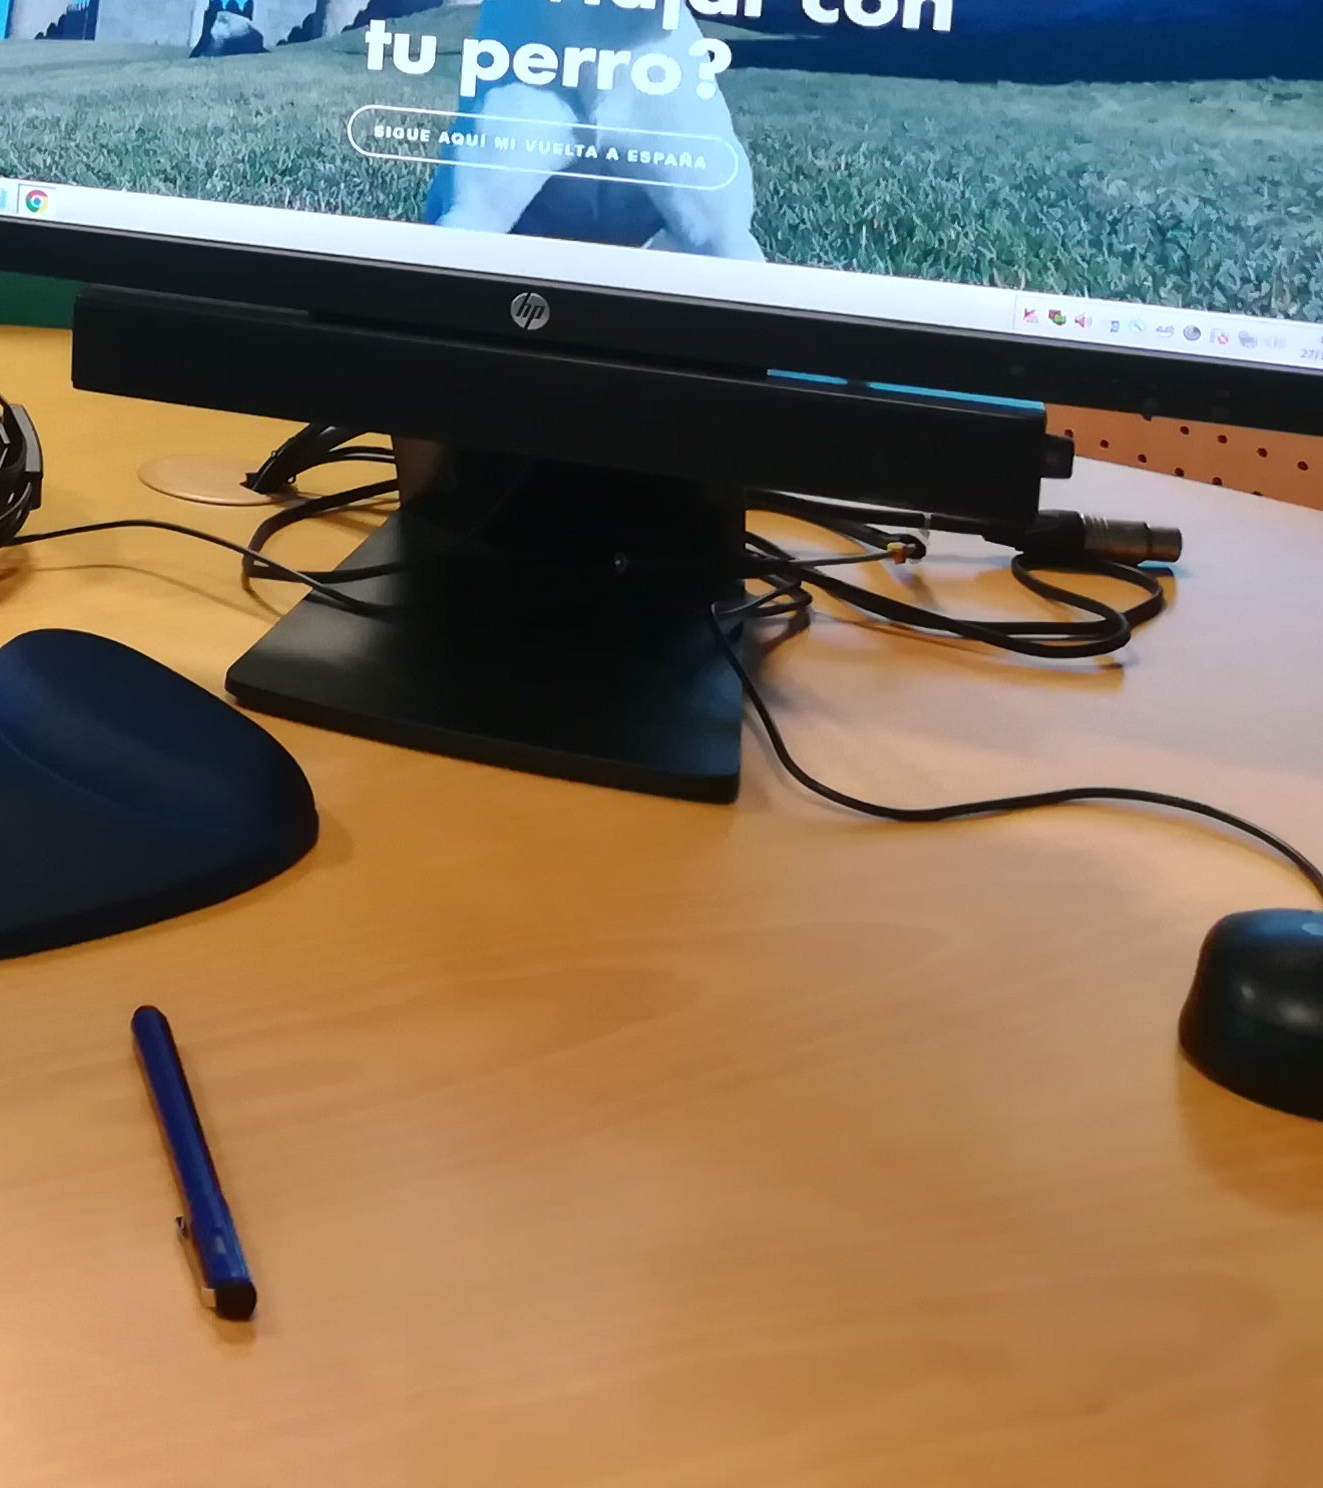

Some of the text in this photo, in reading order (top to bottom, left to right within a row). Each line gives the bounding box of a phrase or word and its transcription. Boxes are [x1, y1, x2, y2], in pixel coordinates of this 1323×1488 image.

[364, 18, 732, 100] tu perro?
[374, 125, 431, 142] SIGUE
[495, 136, 515, 151] MI
[526, 139, 598, 159] VUELTA
[606, 147, 619, 161] A
[627, 148, 706, 169] ESPAÑA
[513, 293, 548, 330] hp
